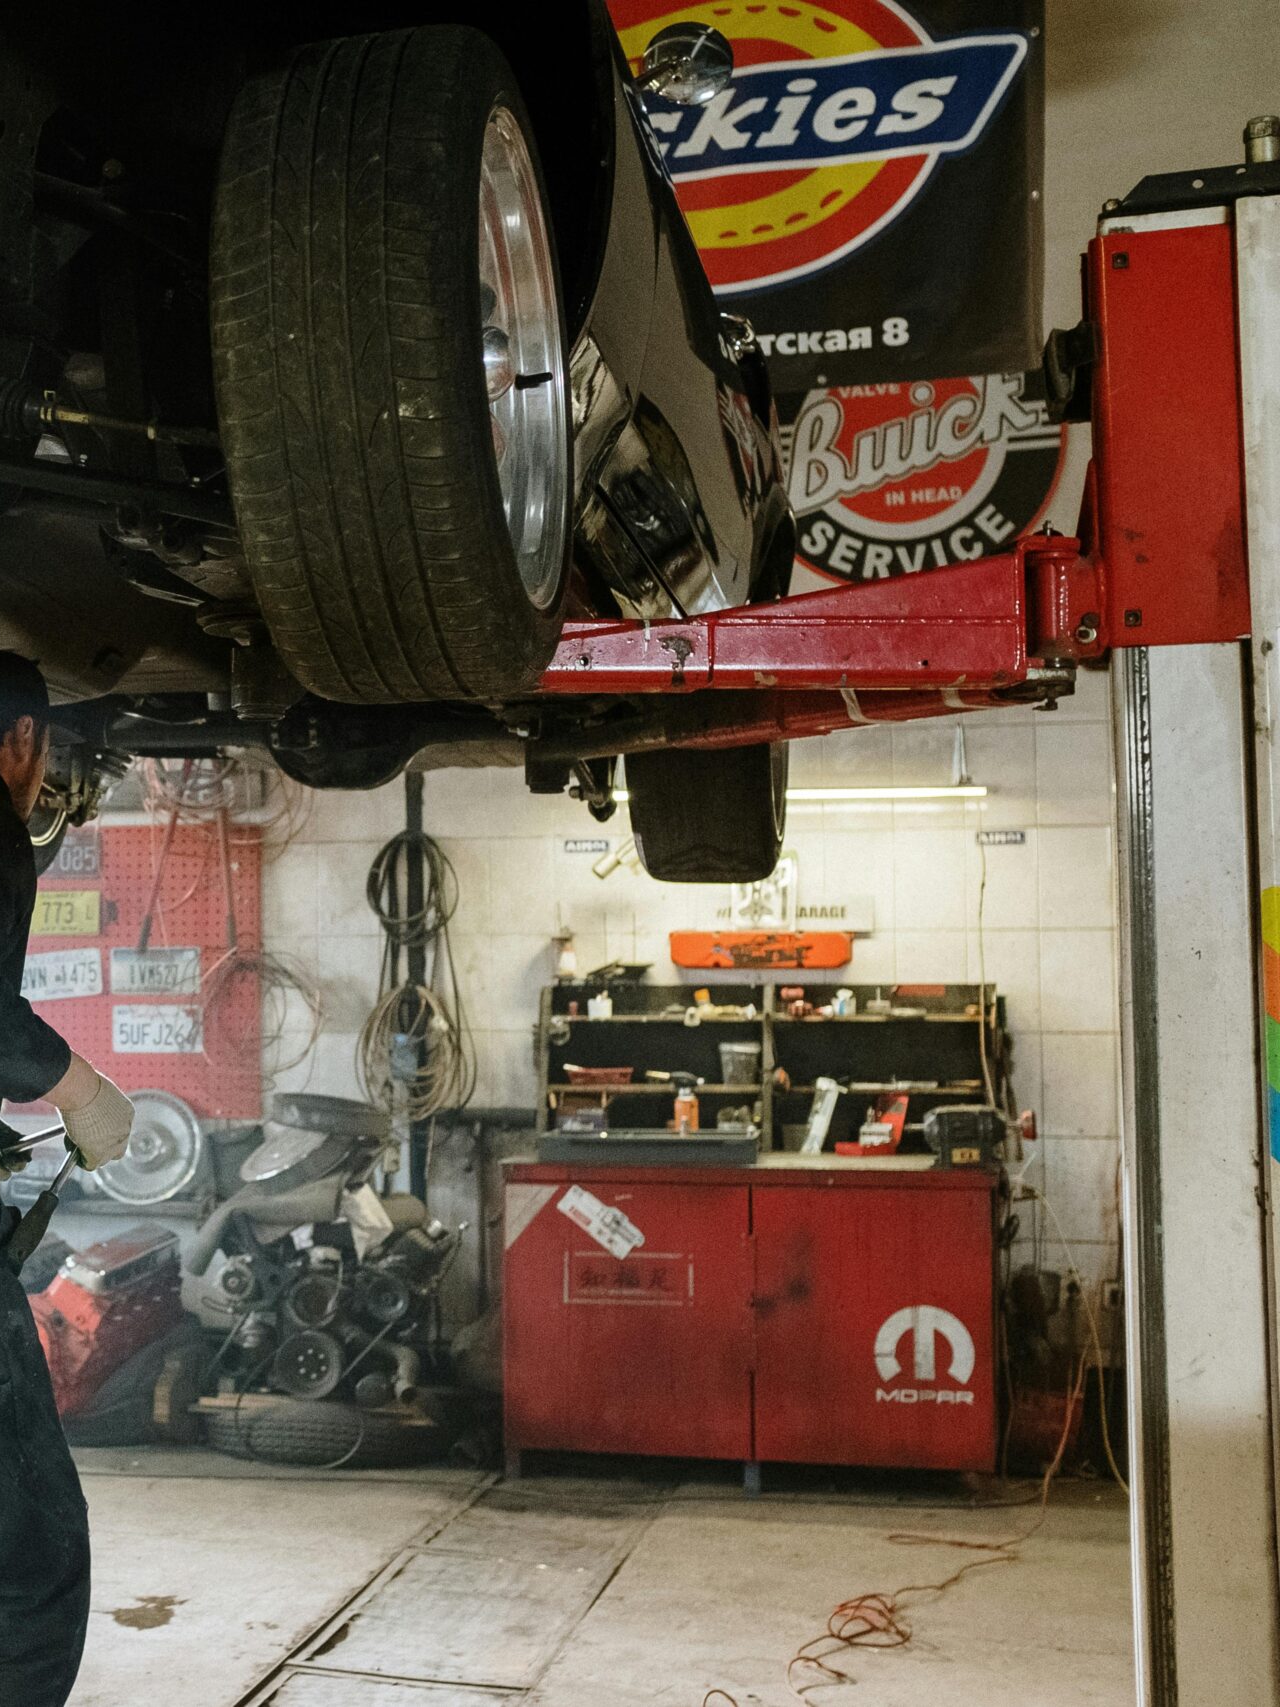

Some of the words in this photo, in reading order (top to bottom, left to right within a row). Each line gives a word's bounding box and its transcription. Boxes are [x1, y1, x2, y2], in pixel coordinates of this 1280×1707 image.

[882, 317, 910, 346] 8
[838, 383, 901, 399] VALVE
[789, 373, 1039, 517] Buick
[885, 491, 906, 506] IN
[911, 486, 963, 504] HEAD
[801, 503, 1016, 579] SERVICE
[42, 901, 74, 924] 773
[796, 906, 846, 918] ARAGE
[876, 1388, 974, 1405] MOPAR
